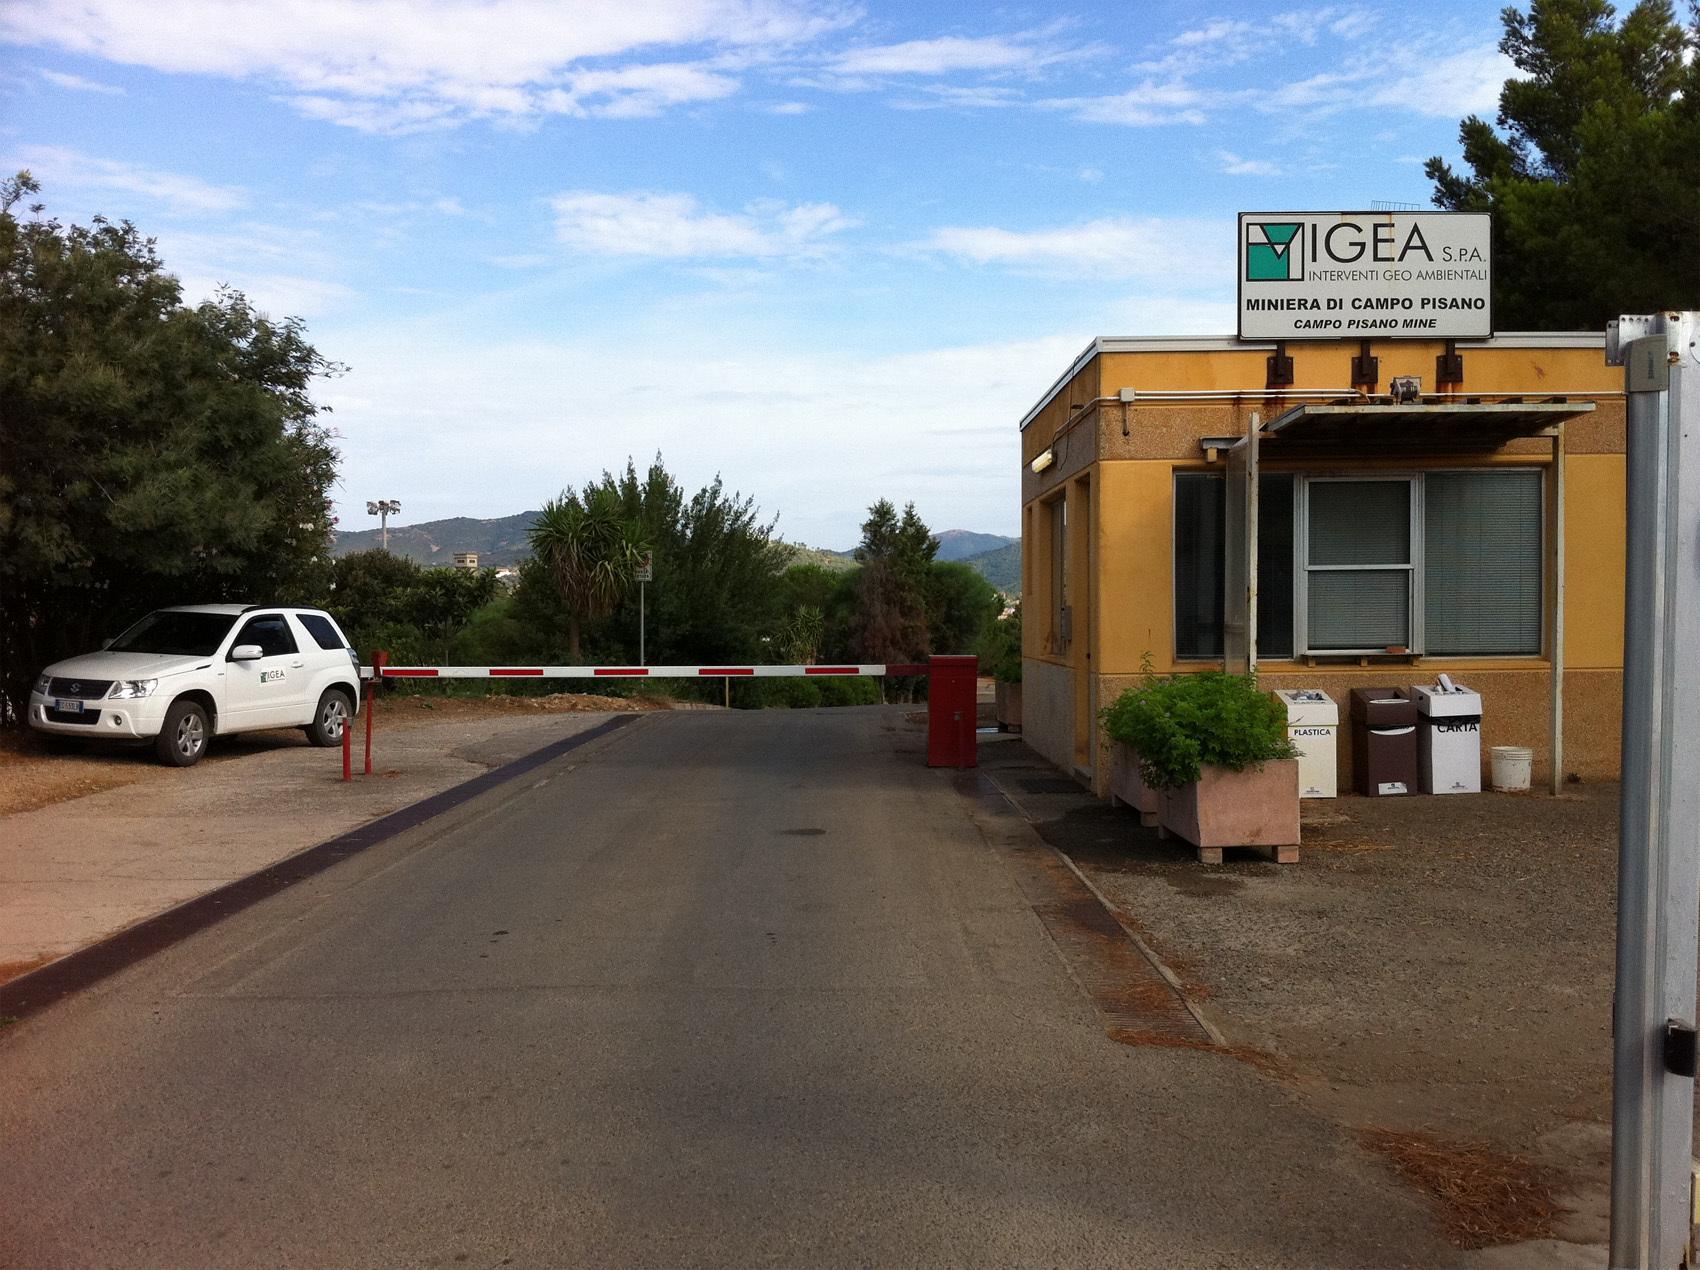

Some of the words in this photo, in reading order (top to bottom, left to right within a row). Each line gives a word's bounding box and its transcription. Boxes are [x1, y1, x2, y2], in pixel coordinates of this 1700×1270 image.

[1311, 222, 1434, 263] IGEA
[1442, 246, 1487, 262] S.P.A.
[1308, 270, 1379, 282] INTERVENTI
[1383, 269, 1412, 281] GEO
[1416, 269, 1487, 281] AMBIENTALI
[1246, 298, 1321, 311] MINIERA
[1326, 298, 1343, 310] DI
[1351, 297, 1413, 310] CAMPO
[1420, 297, 1486, 310] PISANO
[1294, 319, 1342, 329] CAMPO
[1347, 319, 1397, 329] PISANO
[1402, 318, 1437, 329] MINE
[267, 670, 285, 679] IGEA
[1437, 721, 1478, 733] CARTA
